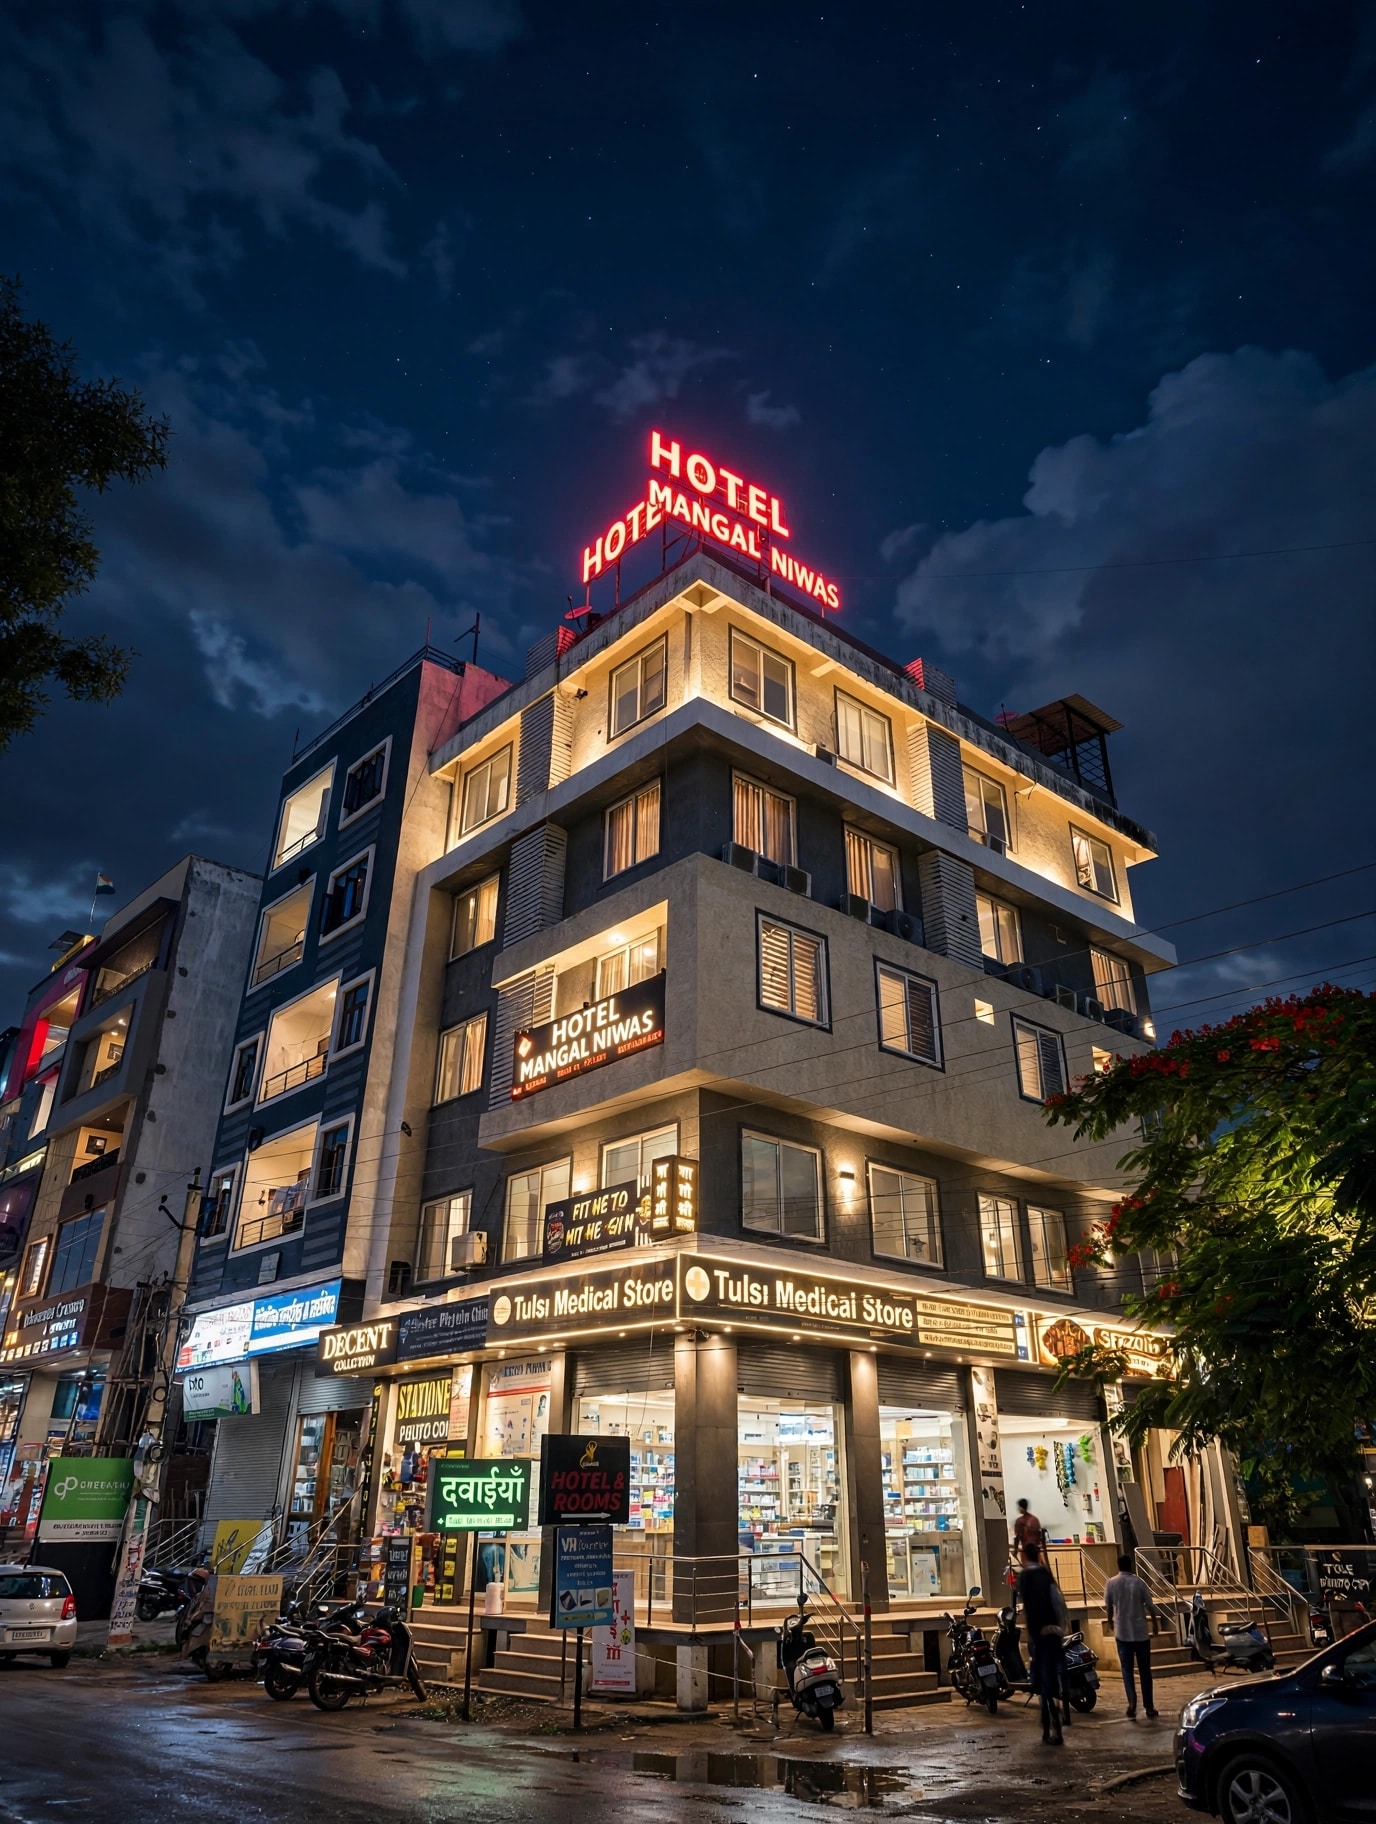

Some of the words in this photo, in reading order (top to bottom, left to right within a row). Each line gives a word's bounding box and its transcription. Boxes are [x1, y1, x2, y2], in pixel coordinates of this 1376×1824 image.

[651, 431, 789, 537] HOTEL
[649, 480, 761, 559] MANGAL
[771, 547, 839, 608] NIWAS
[552, 998, 619, 1046] HOTEL
[520, 1037, 590, 1082] MANGAL
[593, 1010, 653, 1052] NIWAS
[514, 1294, 549, 1320] Tulsi
[554, 1282, 618, 1317] Medical
[623, 1279, 673, 1307] Store
[714, 1270, 768, 1305] Tulsi
[775, 1280, 856, 1319] Medical
[862, 1295, 913, 1328] Store
[322, 1323, 392, 1359] DECENT
[440, 1465, 525, 1510] दवाईयाँ
[551, 1471, 611, 1490] HOTEL
[613, 1471, 625, 1490] &
[553, 1492, 621, 1511] ROOMS
